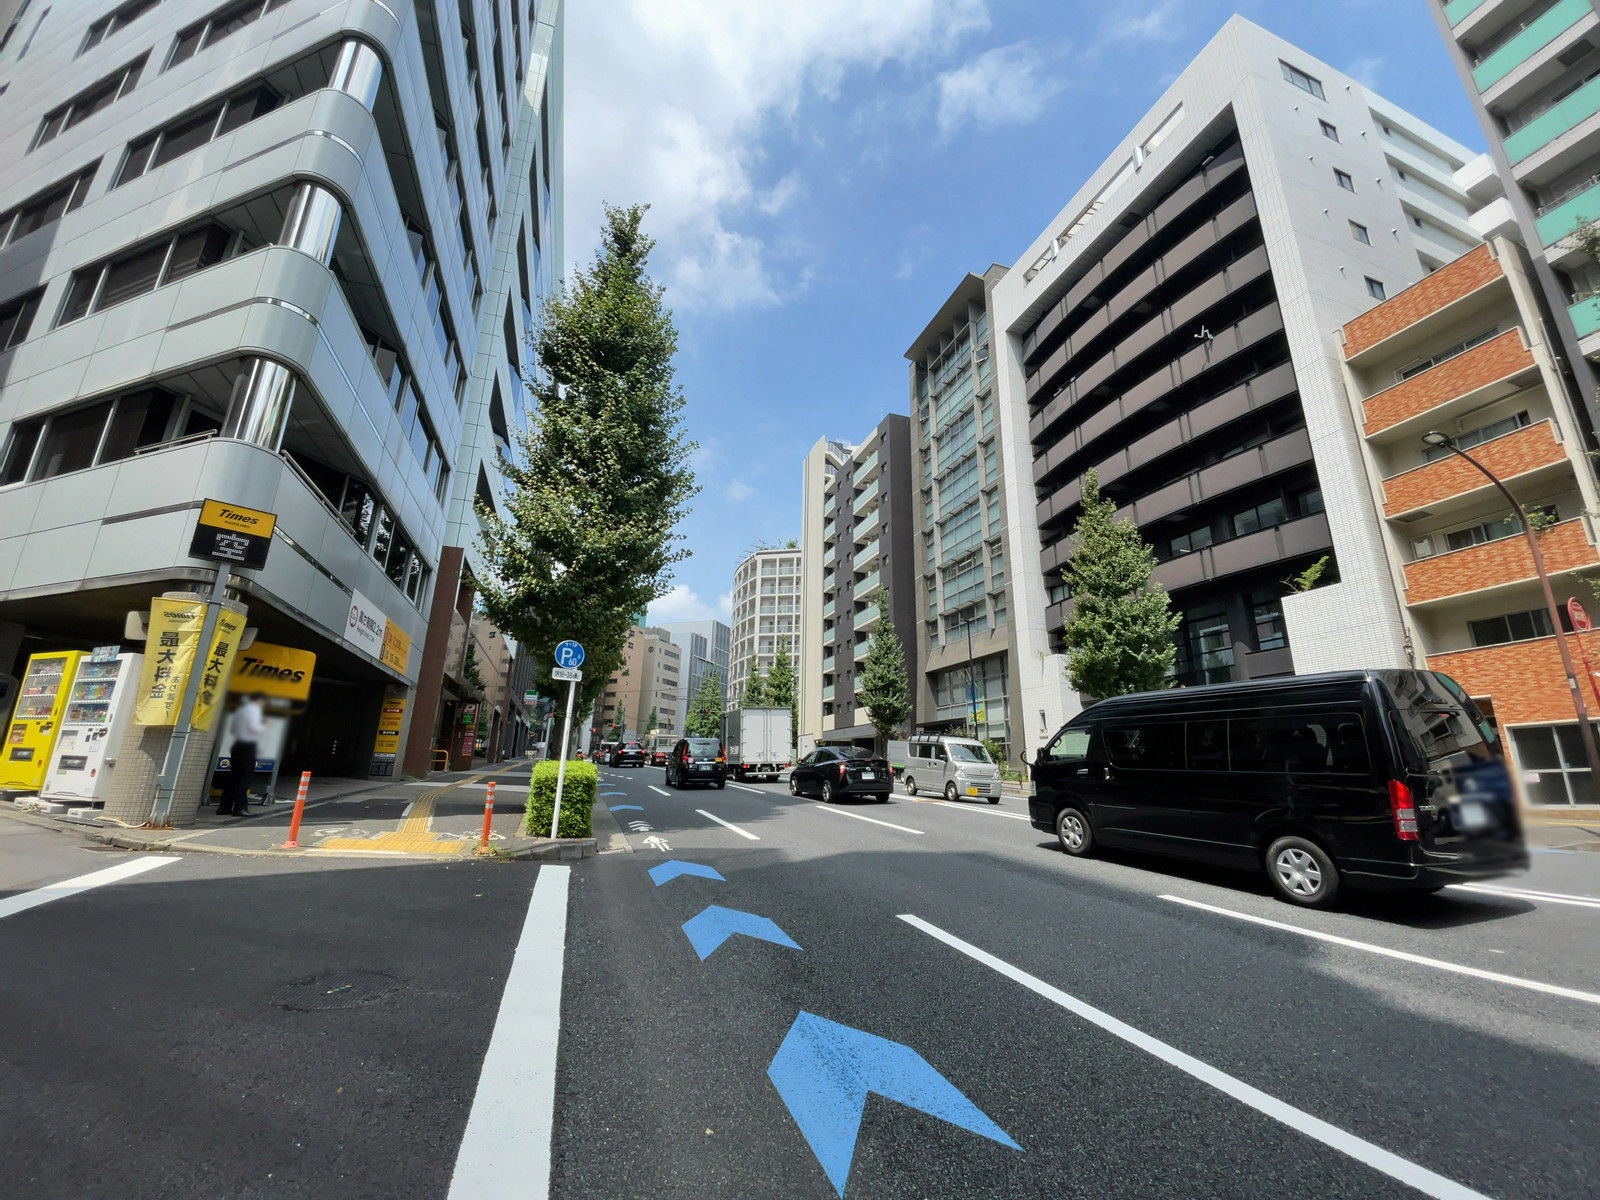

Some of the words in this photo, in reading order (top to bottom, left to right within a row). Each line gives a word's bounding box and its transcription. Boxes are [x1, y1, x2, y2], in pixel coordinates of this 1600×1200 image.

[219, 508, 259, 525] Times
[211, 533, 250, 561] 空
[561, 647, 574, 665] P
[568, 657, 577, 666] 60
[202, 641, 229, 706] 最大料金
[238, 656, 306, 683] Times
